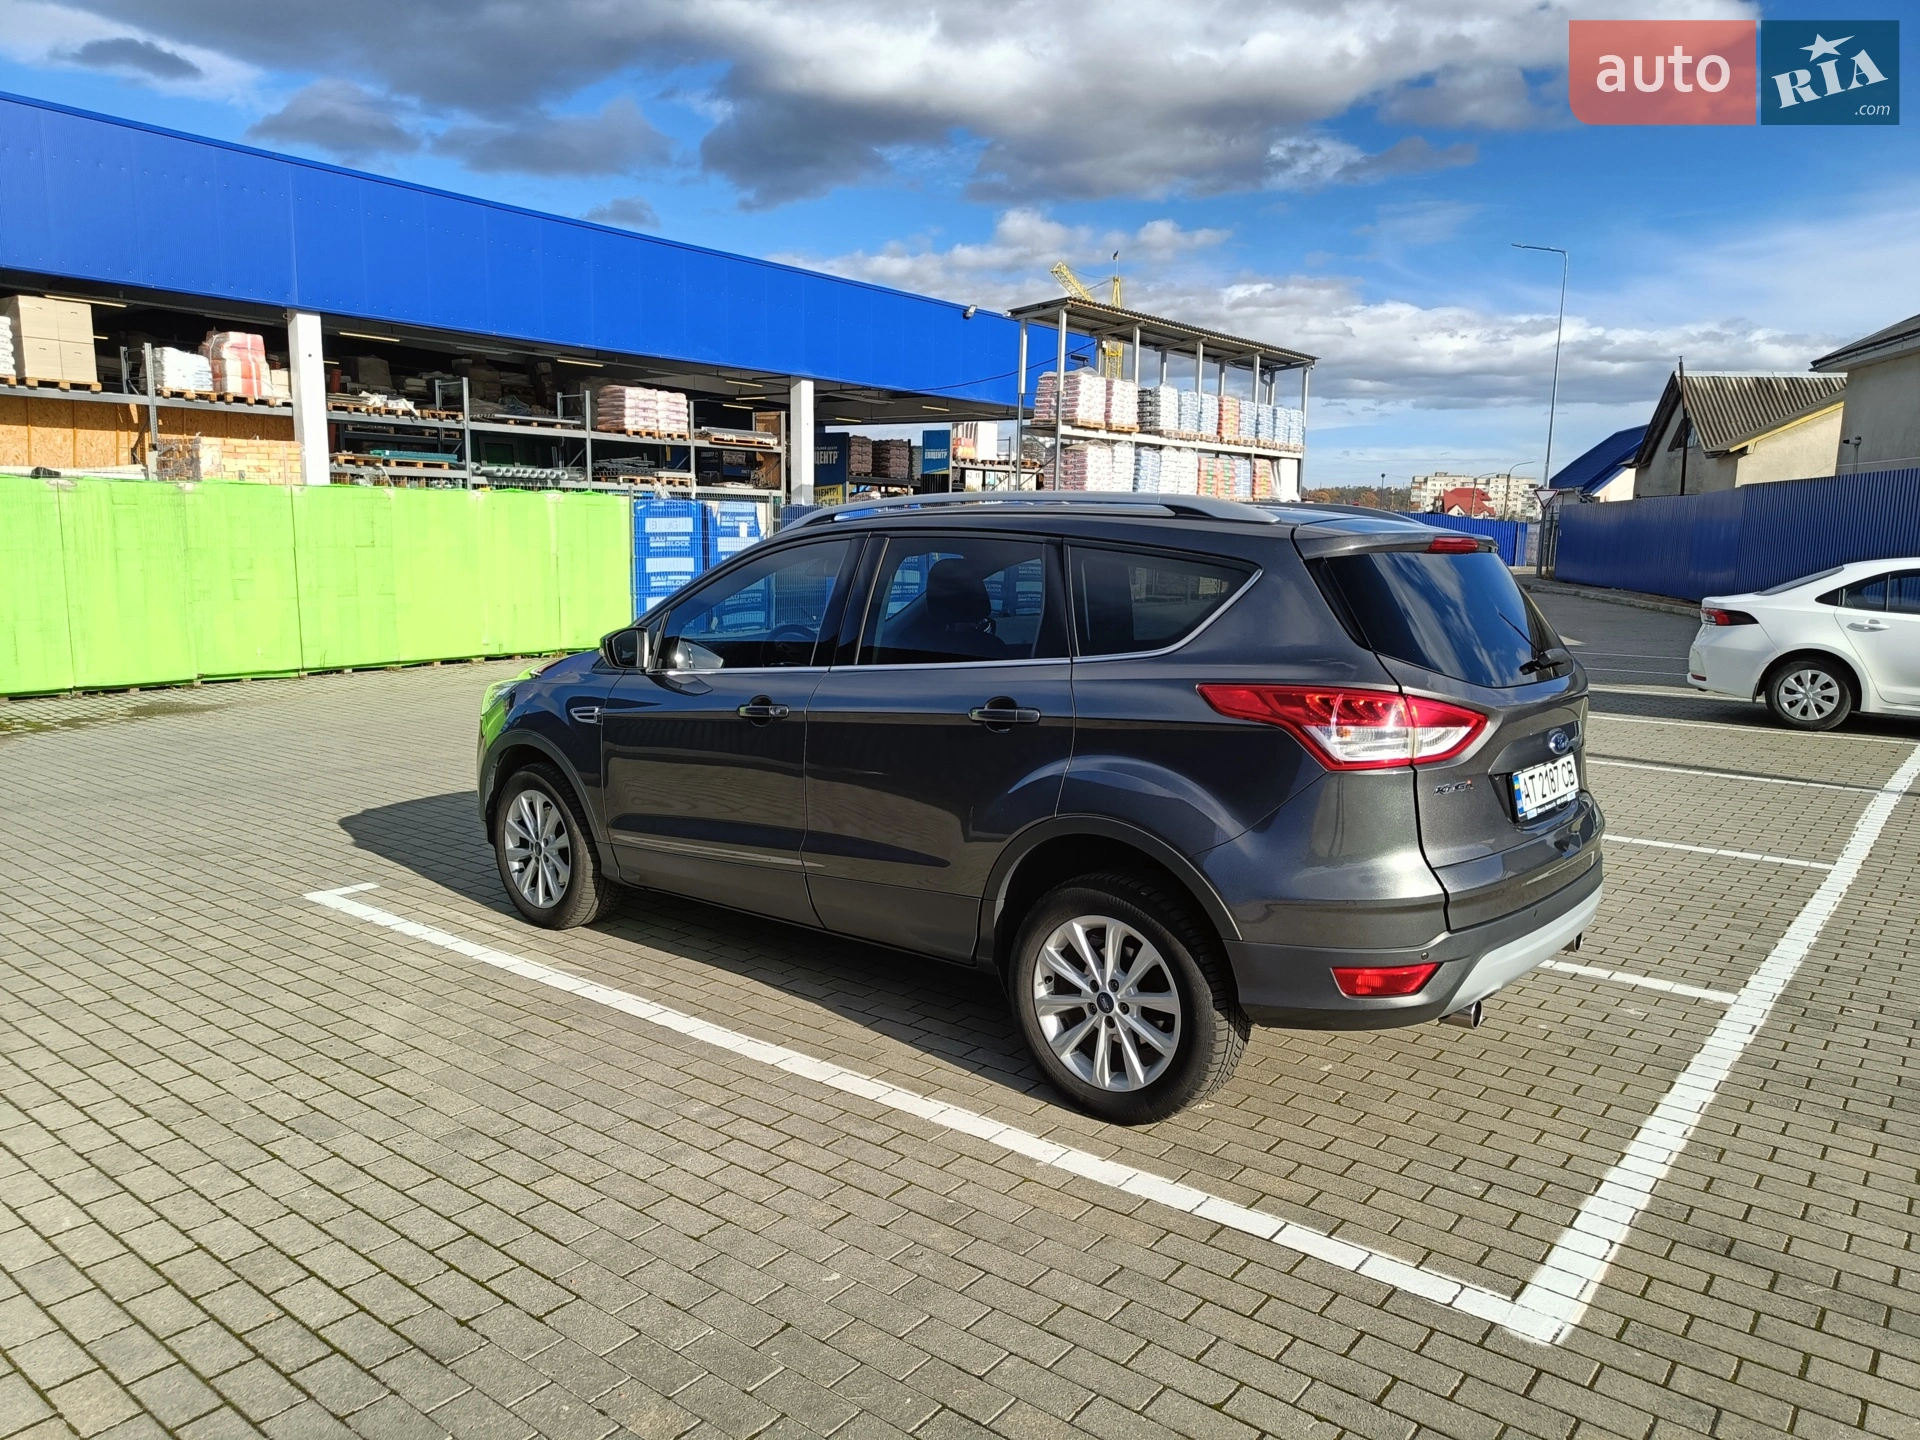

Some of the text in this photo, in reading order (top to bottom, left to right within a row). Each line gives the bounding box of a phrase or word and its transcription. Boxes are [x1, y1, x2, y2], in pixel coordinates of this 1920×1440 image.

[1523, 760, 1575, 806] AT 2187 CB
